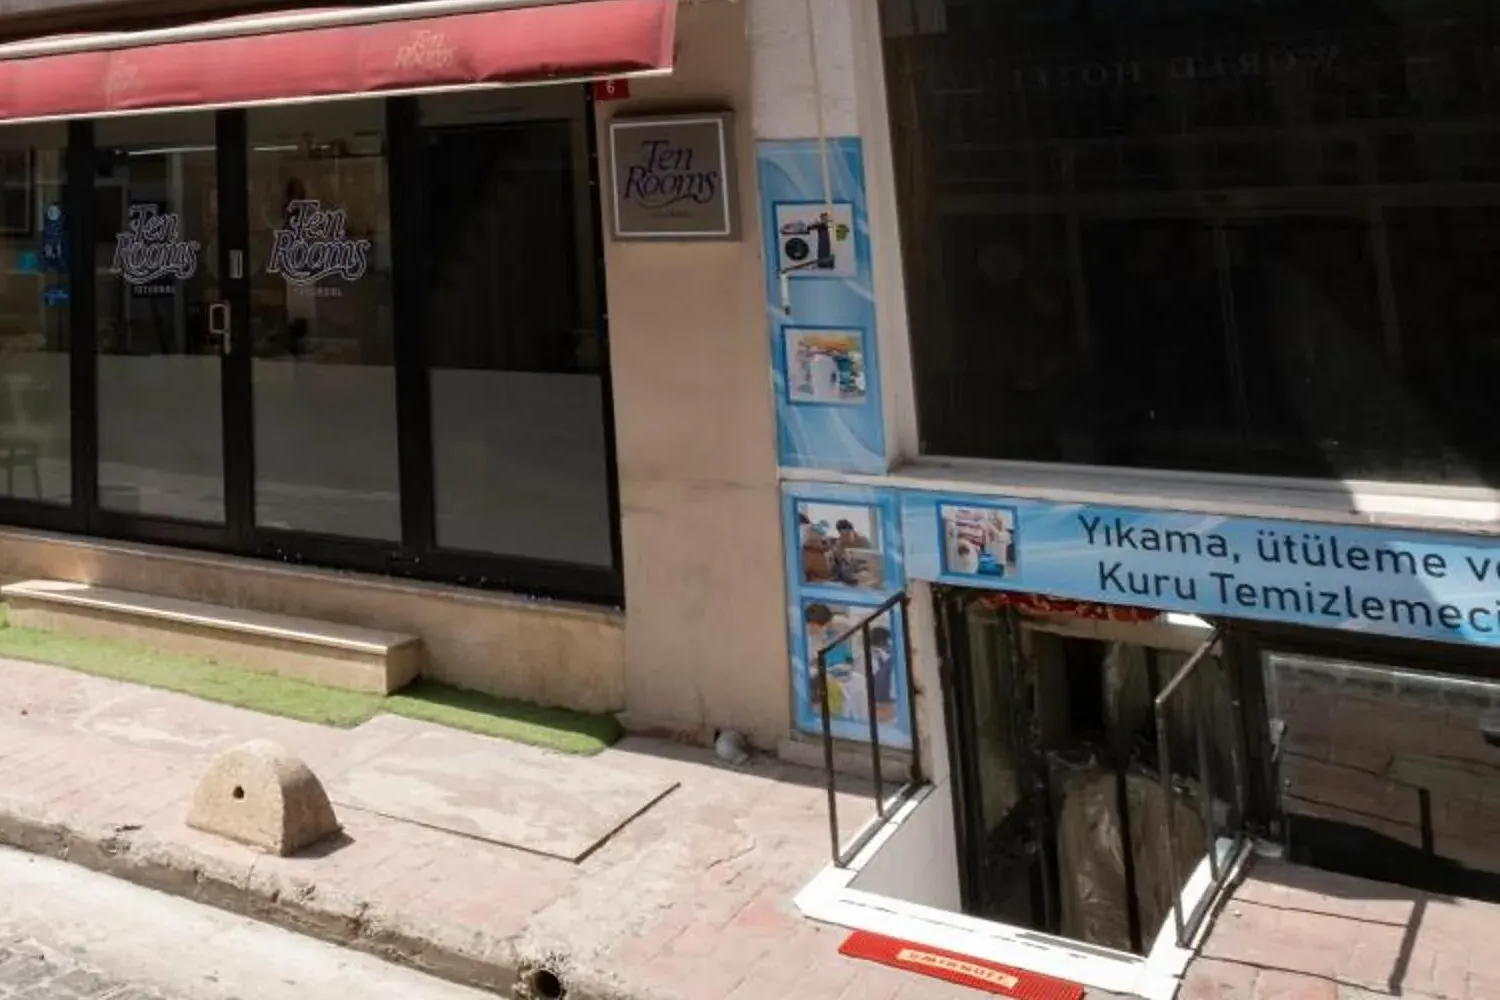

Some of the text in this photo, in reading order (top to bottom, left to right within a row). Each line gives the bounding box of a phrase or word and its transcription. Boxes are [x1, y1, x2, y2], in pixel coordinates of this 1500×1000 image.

[642, 140, 693, 173] Ten
[624, 165, 718, 209] Rooms
[129, 203, 179, 242] Ten
[287, 199, 347, 242] Ten
[108, 232, 201, 285] Rooms
[266, 229, 372, 284] Rooms
[1078, 514, 1240, 564] Yıkama,
[1257, 529, 1446, 578] ütüleme
[1099, 561, 1196, 601] Kuru
